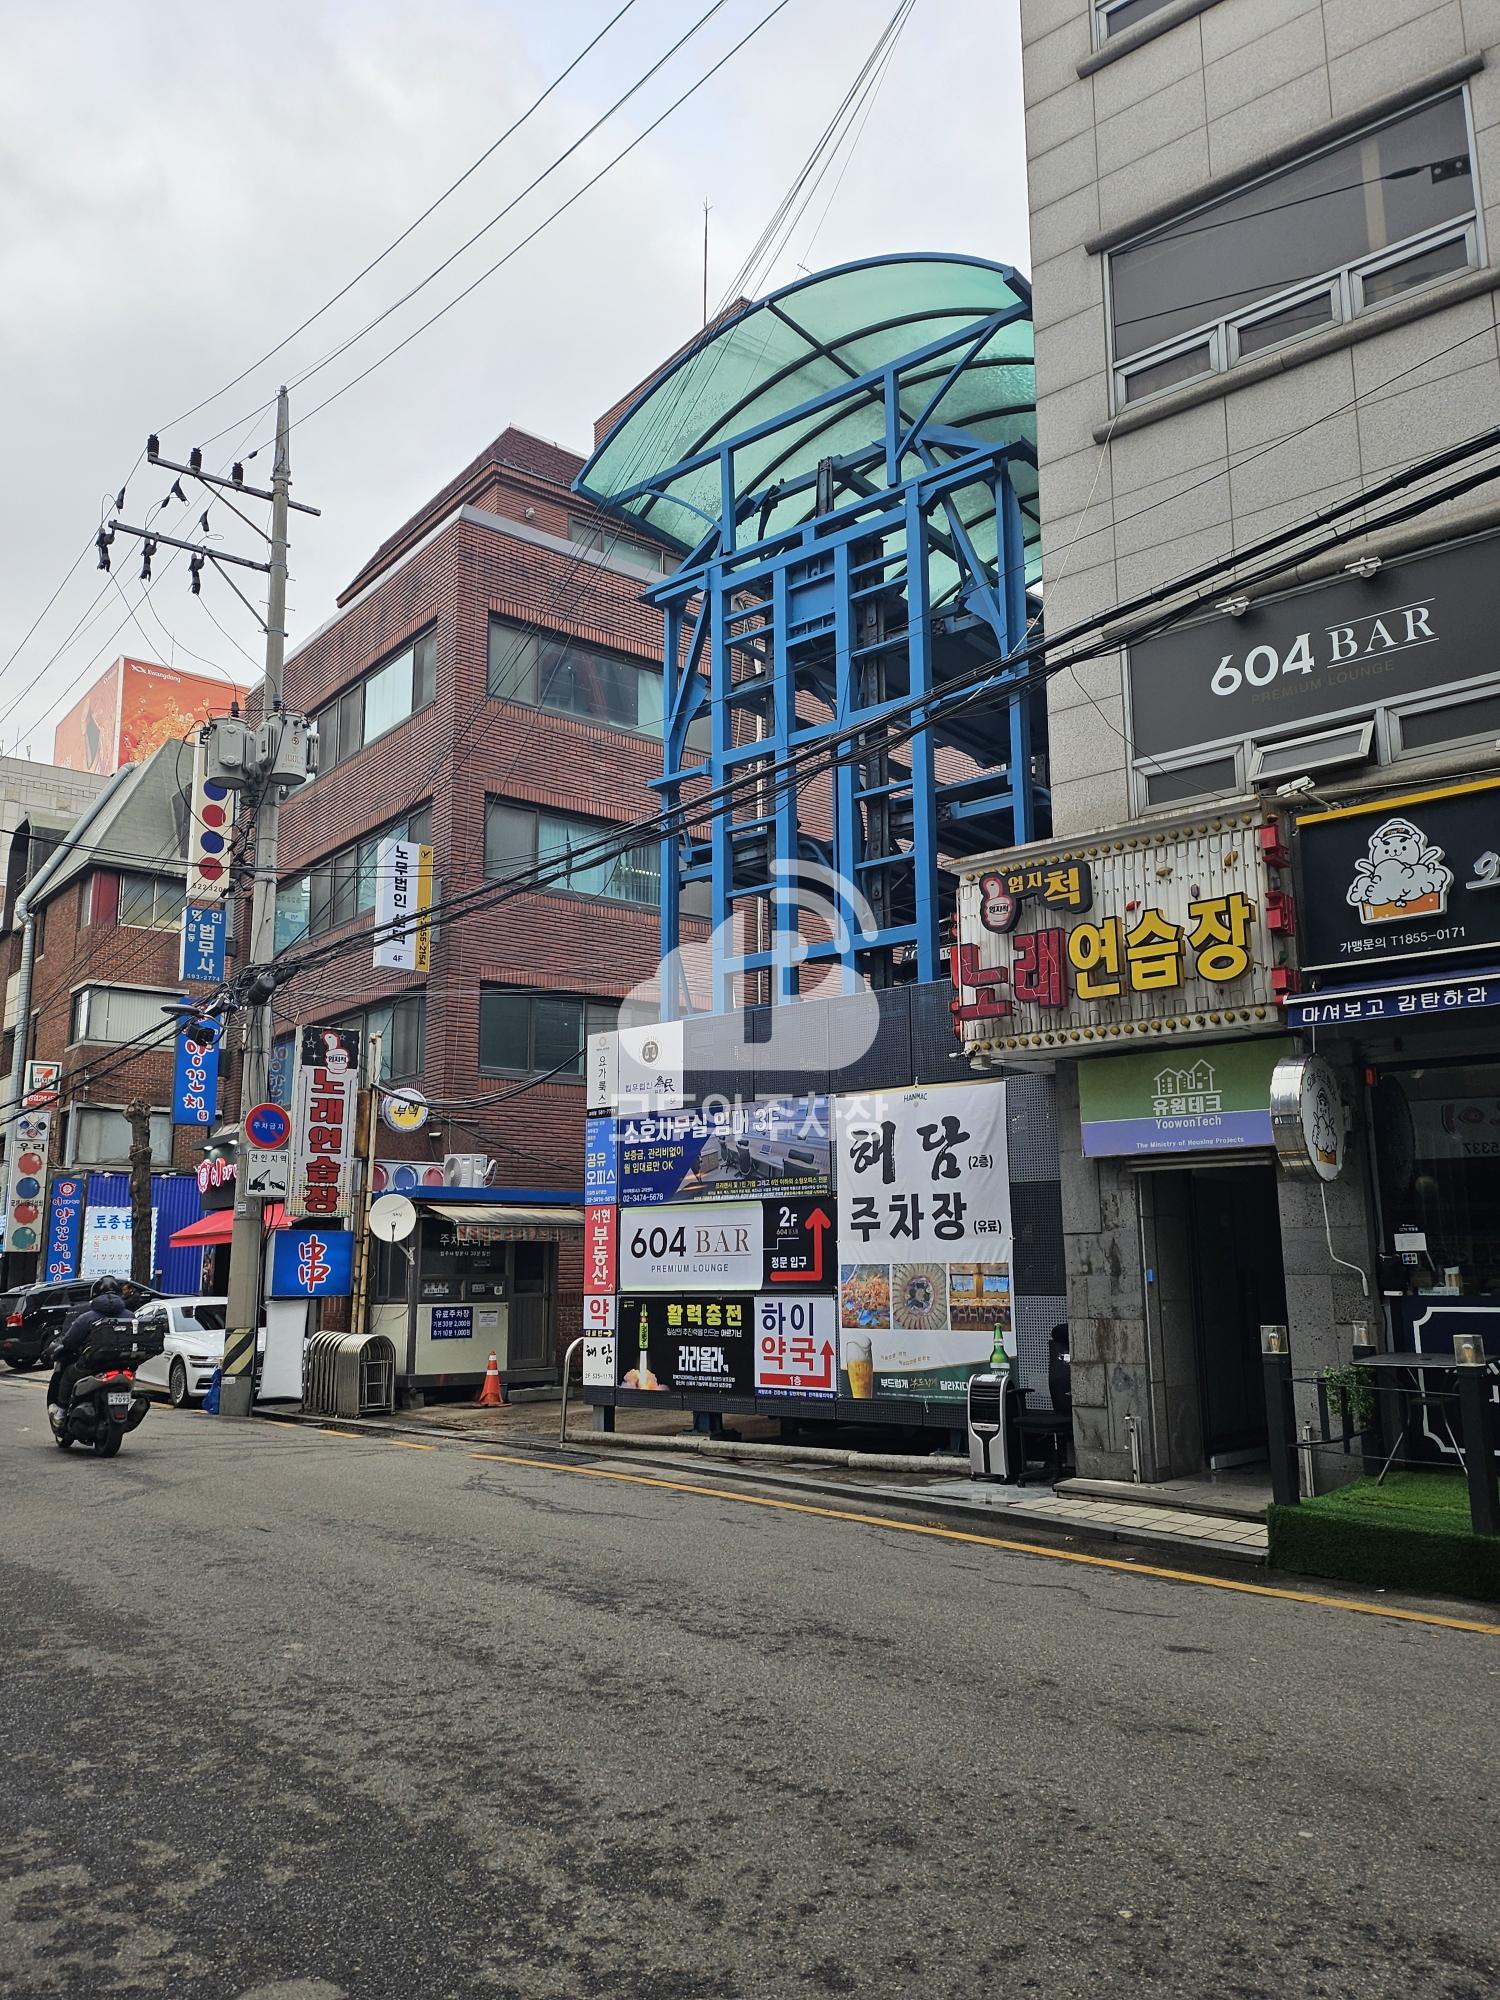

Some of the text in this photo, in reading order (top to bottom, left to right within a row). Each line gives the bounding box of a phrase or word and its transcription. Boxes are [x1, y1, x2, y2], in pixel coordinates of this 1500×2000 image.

[1210, 606, 1435, 696] 604 BAR
[147, 669, 181, 684] Kwangdong
[1250, 659, 1395, 705] PREMIUM LOUNGE
[393, 844, 409, 909] 노무법인
[1007, 867, 1081, 906] 엄지척
[1340, 926, 1466, 954] 가맹문의 T1855-0171
[197, 923, 215, 975] 법무사
[957, 891, 1256, 1021] 노래연습장
[392, 954, 404, 963] 4F
[1302, 986, 1488, 1022] 마셔보고 감탄하라
[625, 1080, 653, 1094] 법무법인
[903, 1092, 928, 1102] HANMAC
[1152, 1094, 1223, 1117] 유원테크
[253, 1120, 284, 1131] 주차금지
[624, 1113, 708, 1145] 소호사무실
[714, 1109, 749, 1137] 임대
[754, 1106, 781, 1132] 3F
[1155, 1115, 1222, 1130] YoowonTech
[17, 1142, 45, 1152] 우리
[303, 1068, 346, 1214] 노래연습장
[1136, 1141, 1149, 1149] The
[1150, 1140, 1176, 1150] Ministry
[1215, 1136, 1244, 1145] Projects
[250, 1153, 287, 1164] 견인지역
[586, 1152, 607, 1168] 공유
[623, 1145, 684, 1161] 보증금, 관리비없이
[623, 1160, 674, 1175] 월 임대료만 OK
[968, 1155, 993, 1170] (2층)
[586, 1169, 616, 1186] 오피스
[591, 1208, 611, 1223] 서현
[779, 1206, 798, 1227] 2F
[850, 1192, 1002, 1242] 주차장 (유료)
[630, 1226, 750, 1259] 604 BAR
[298, 1233, 331, 1293] 串
[592, 1225, 609, 1286] 부동산
[771, 1256, 807, 1269] 정문 입구
[651, 1263, 729, 1273] PREMIUM LOUNGE
[434, 1309, 470, 1319] 유료주차장
[589, 1298, 609, 1327] 약
[761, 1302, 814, 1337] 하이
[761, 1336, 816, 1371] 약국
[789, 1375, 801, 1386] 1층
[880, 1377, 909, 1390] 부드럽게
